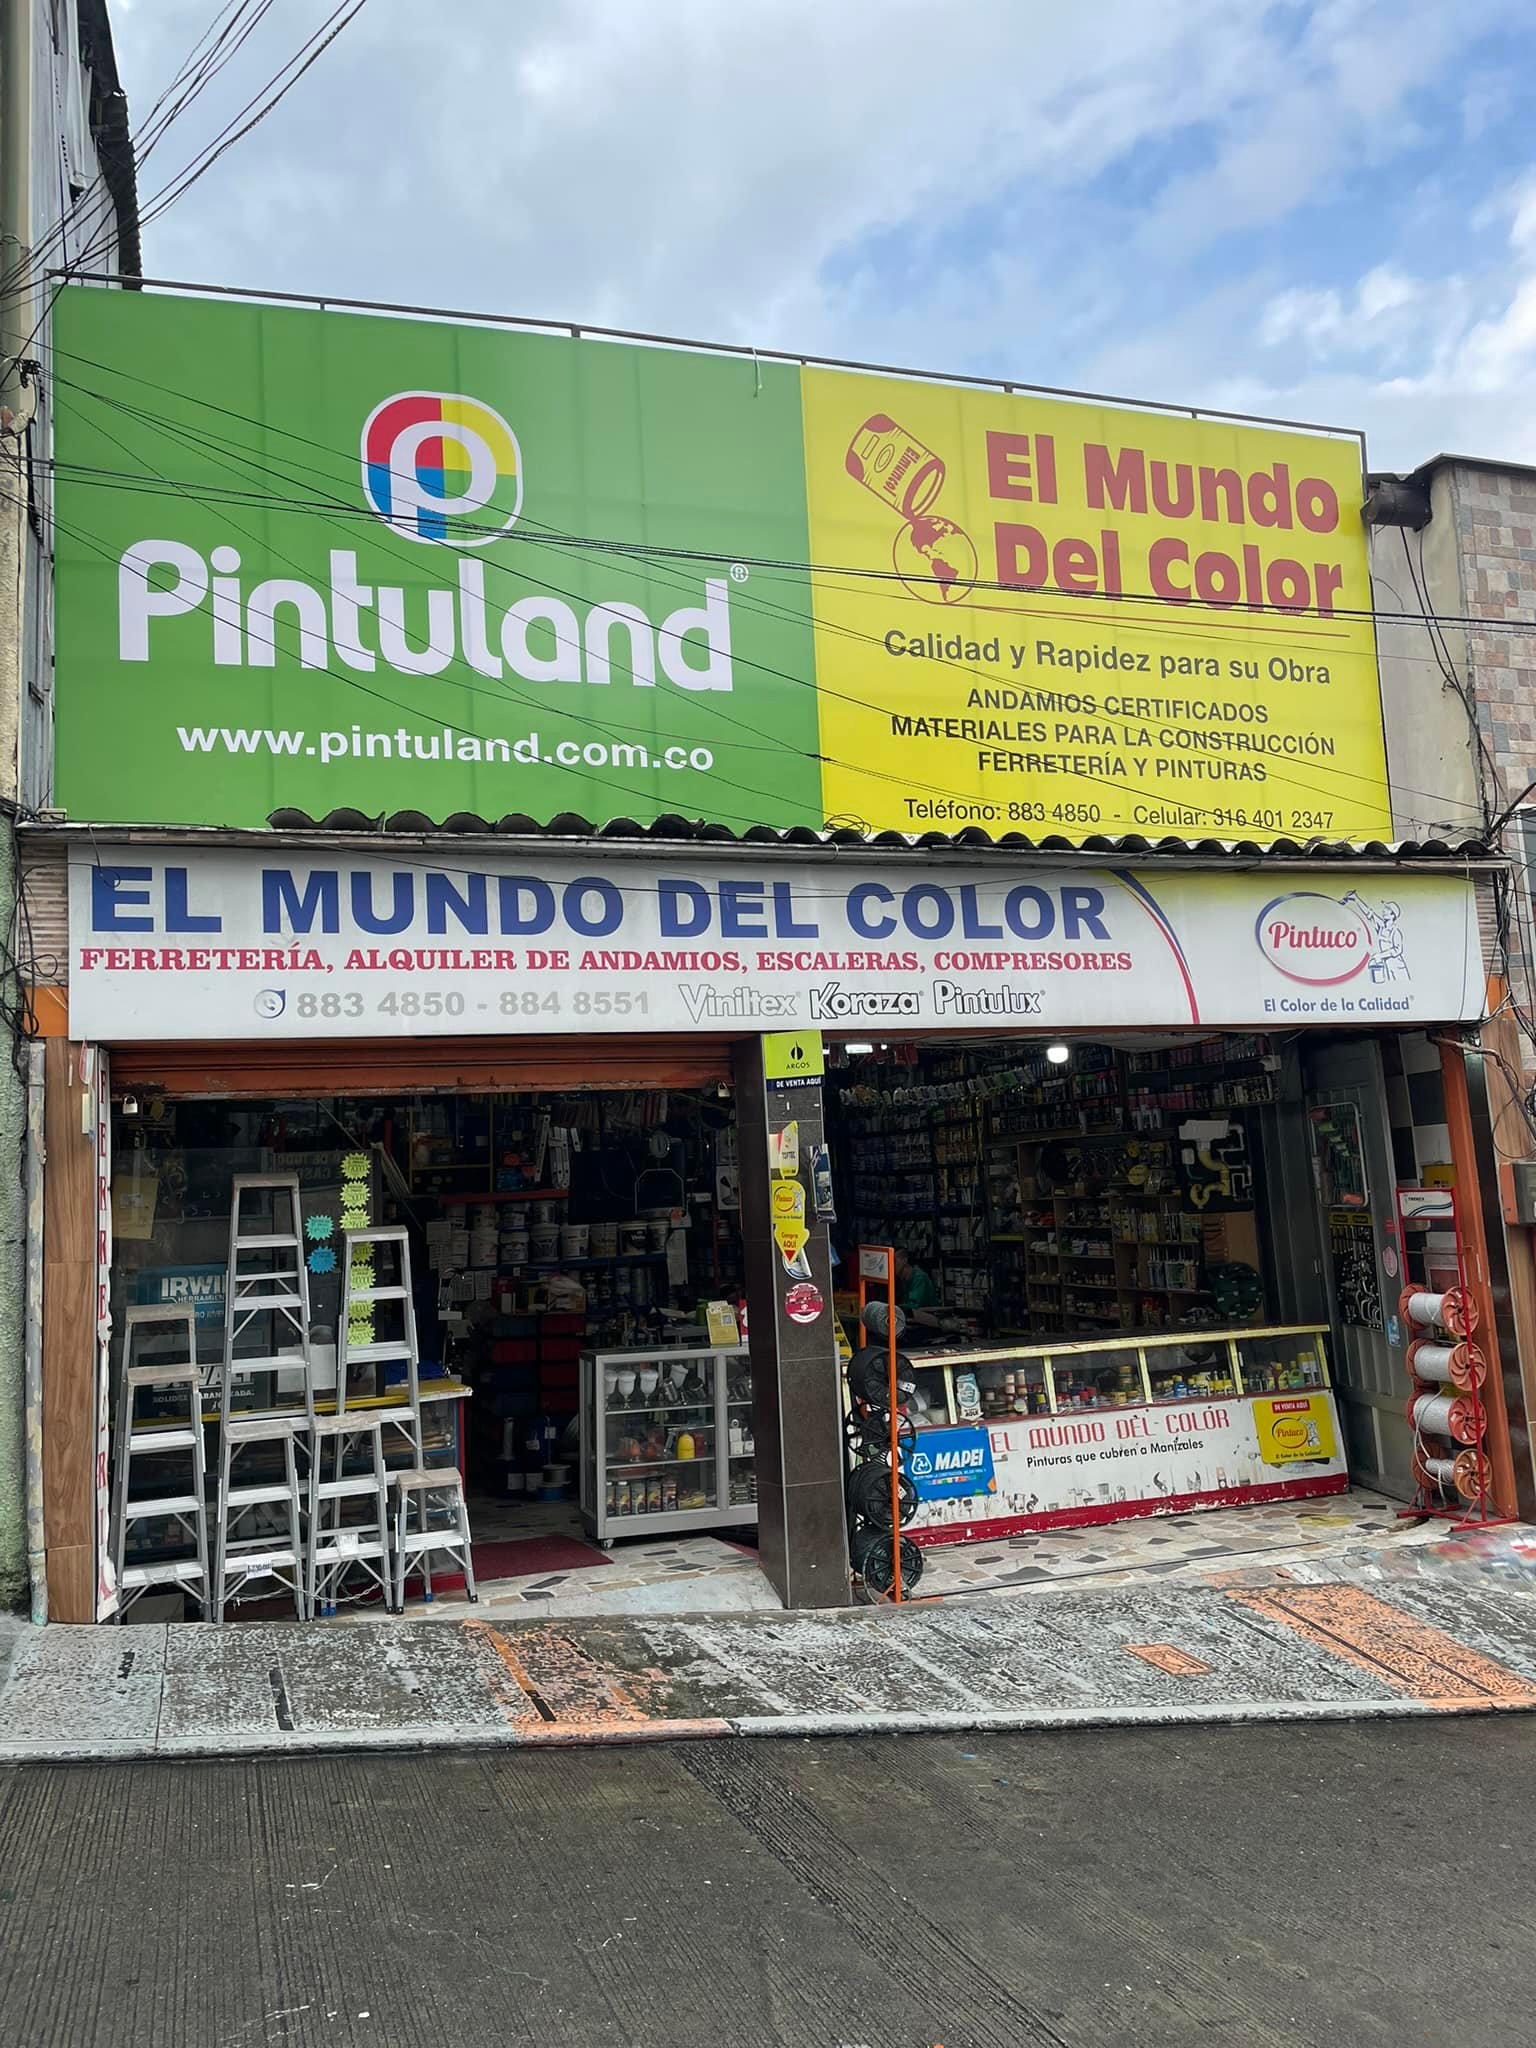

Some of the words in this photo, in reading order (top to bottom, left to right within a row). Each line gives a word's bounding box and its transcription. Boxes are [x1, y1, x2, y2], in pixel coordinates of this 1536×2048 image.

[985, 430, 1058, 504] El
[1083, 443, 1340, 534] Mundo
[993, 521, 1121, 601] Del
[1148, 536, 1343, 619] Color
[884, 629, 1001, 662] Calidad
[1010, 644, 1027, 670] y
[1036, 639, 1151, 674] Rapidez
[1160, 654, 1220, 679] para
[1229, 659, 1260, 679] su
[1268, 656, 1331, 684] Obra
[967, 687, 1098, 716] ANDAMIOS
[1104, 695, 1269, 724] CERTIFICADOS
[177, 726, 714, 772] www.pintuland.com.co
[891, 715, 1047, 743] MATERIALES
[1055, 723, 1117, 746] PARA
[1124, 726, 1153, 747] LA
[1159, 729, 1336, 756] CONSTRUCCIÓN
[978, 751, 1127, 777] FERRETERÍA
[1133, 757, 1148, 777] Y
[1156, 758, 1267, 782] PINTURAS
[904, 798, 1001, 821] Teléfono:
[1008, 802, 1046, 822] 883
[1052, 803, 1101, 823] 4850
[1134, 804, 1207, 827] Celular:
[1213, 808, 1247, 827] 316
[1253, 809, 1284, 829] 401
[1292, 810, 1334, 830] 2347
[92, 865, 222, 933] EL
[262, 869, 624, 937] MUNDO
[658, 879, 820, 939] DEL
[846, 882, 1112, 941] COLOR
[1268, 921, 1358, 949] Pintuco
[80, 941, 334, 974] FERRETERÍA,
[344, 948, 517, 972] ALQUILER
[526, 950, 570, 971] DE
[579, 950, 749, 974] ANDAMIOS,
[757, 951, 926, 974] ESCALERAS,
[934, 952, 1132, 971] COMPRESORES
[296, 991, 364, 1018] 883
[377, 991, 465, 1017] 4850
[477, 1002, 488, 1010] -
[499, 990, 561, 1016] 884
[573, 990, 649, 1016] 8551
[678, 983, 797, 1024] Viniltex
[809, 982, 921, 1020] Koraza
[933, 980, 1042, 1015] Pintulux
[1264, 999, 1276, 1012] El
[1280, 997, 1317, 1013] Color
[1320, 998, 1338, 1012] de
[1342, 997, 1355, 1011] la
[1358, 996, 1410, 1011] Calidad
[785, 1062, 810, 1070] ARGOS
[776, 1081, 785, 1089] DE
[785, 1079, 806, 1088] VENTA
[990, 1431, 1019, 1454] EL
[1116, 1417, 1156, 1440] DEL
[1166, 1408, 1230, 1434] COLOR
[935, 1448, 984, 1471] MAPEI
[1027, 1453, 1072, 1469] Pinturas
[1075, 1452, 1097, 1464] que
[1099, 1445, 1137, 1461] cubren
[1140, 1446, 1148, 1455] a
[1150, 1439, 1204, 1454] Manizales
